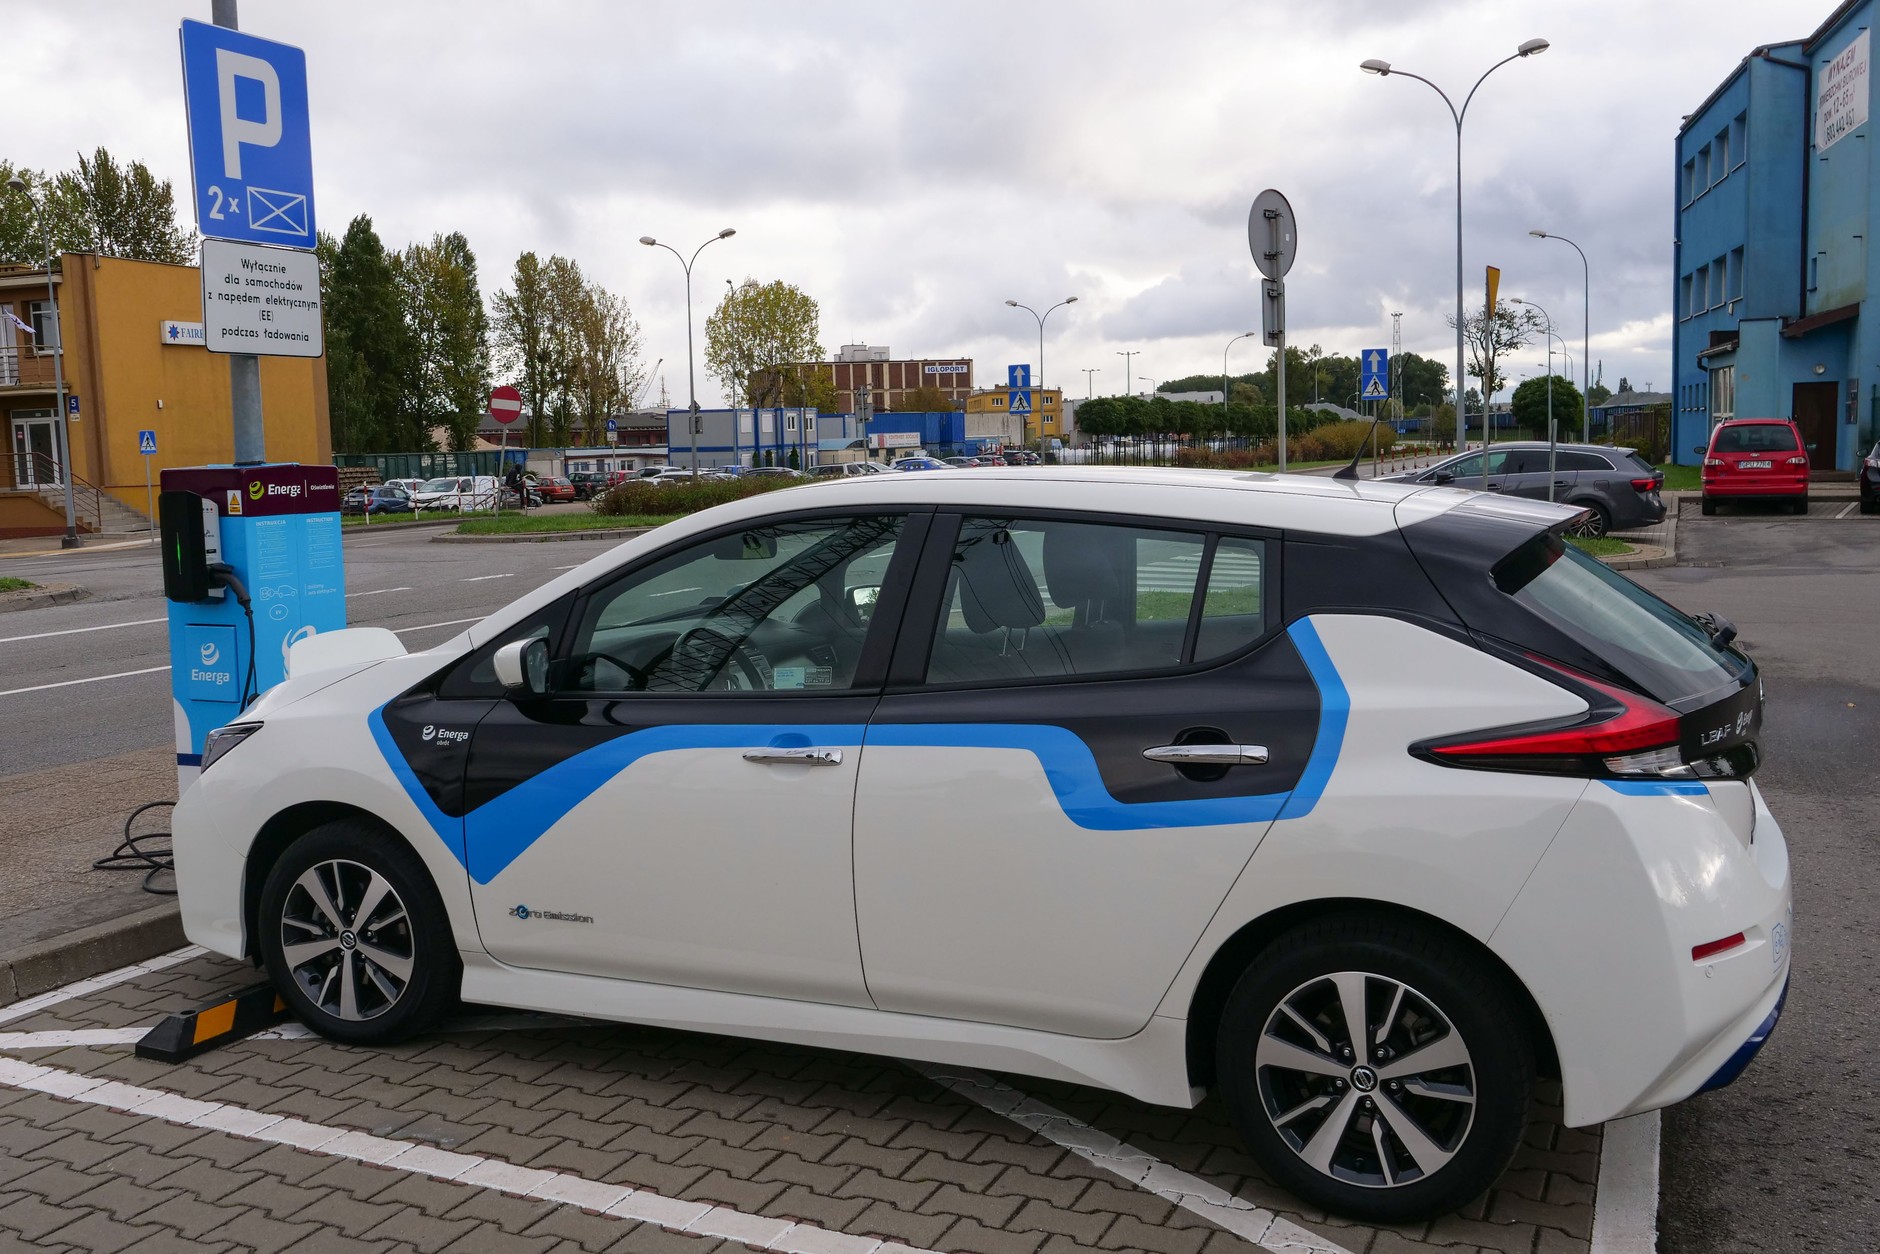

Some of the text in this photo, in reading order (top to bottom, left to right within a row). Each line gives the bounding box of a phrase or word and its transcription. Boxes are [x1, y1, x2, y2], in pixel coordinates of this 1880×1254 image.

[216, 47, 283, 180] P
[240, 258, 287, 274] Wyłącznie
[224, 274, 303, 292] dla samochodów
[207, 291, 319, 311] z napędem elektrycznym
[258, 309, 275, 323] (EE)
[221, 326, 310, 342] podczas ładowania
[267, 483, 301, 497] Energa
[191, 668, 230, 685] Energa
[438, 728, 469, 742] Energa
[1700, 723, 1732, 746] LEAF
[543, 910, 595, 924] Emission
